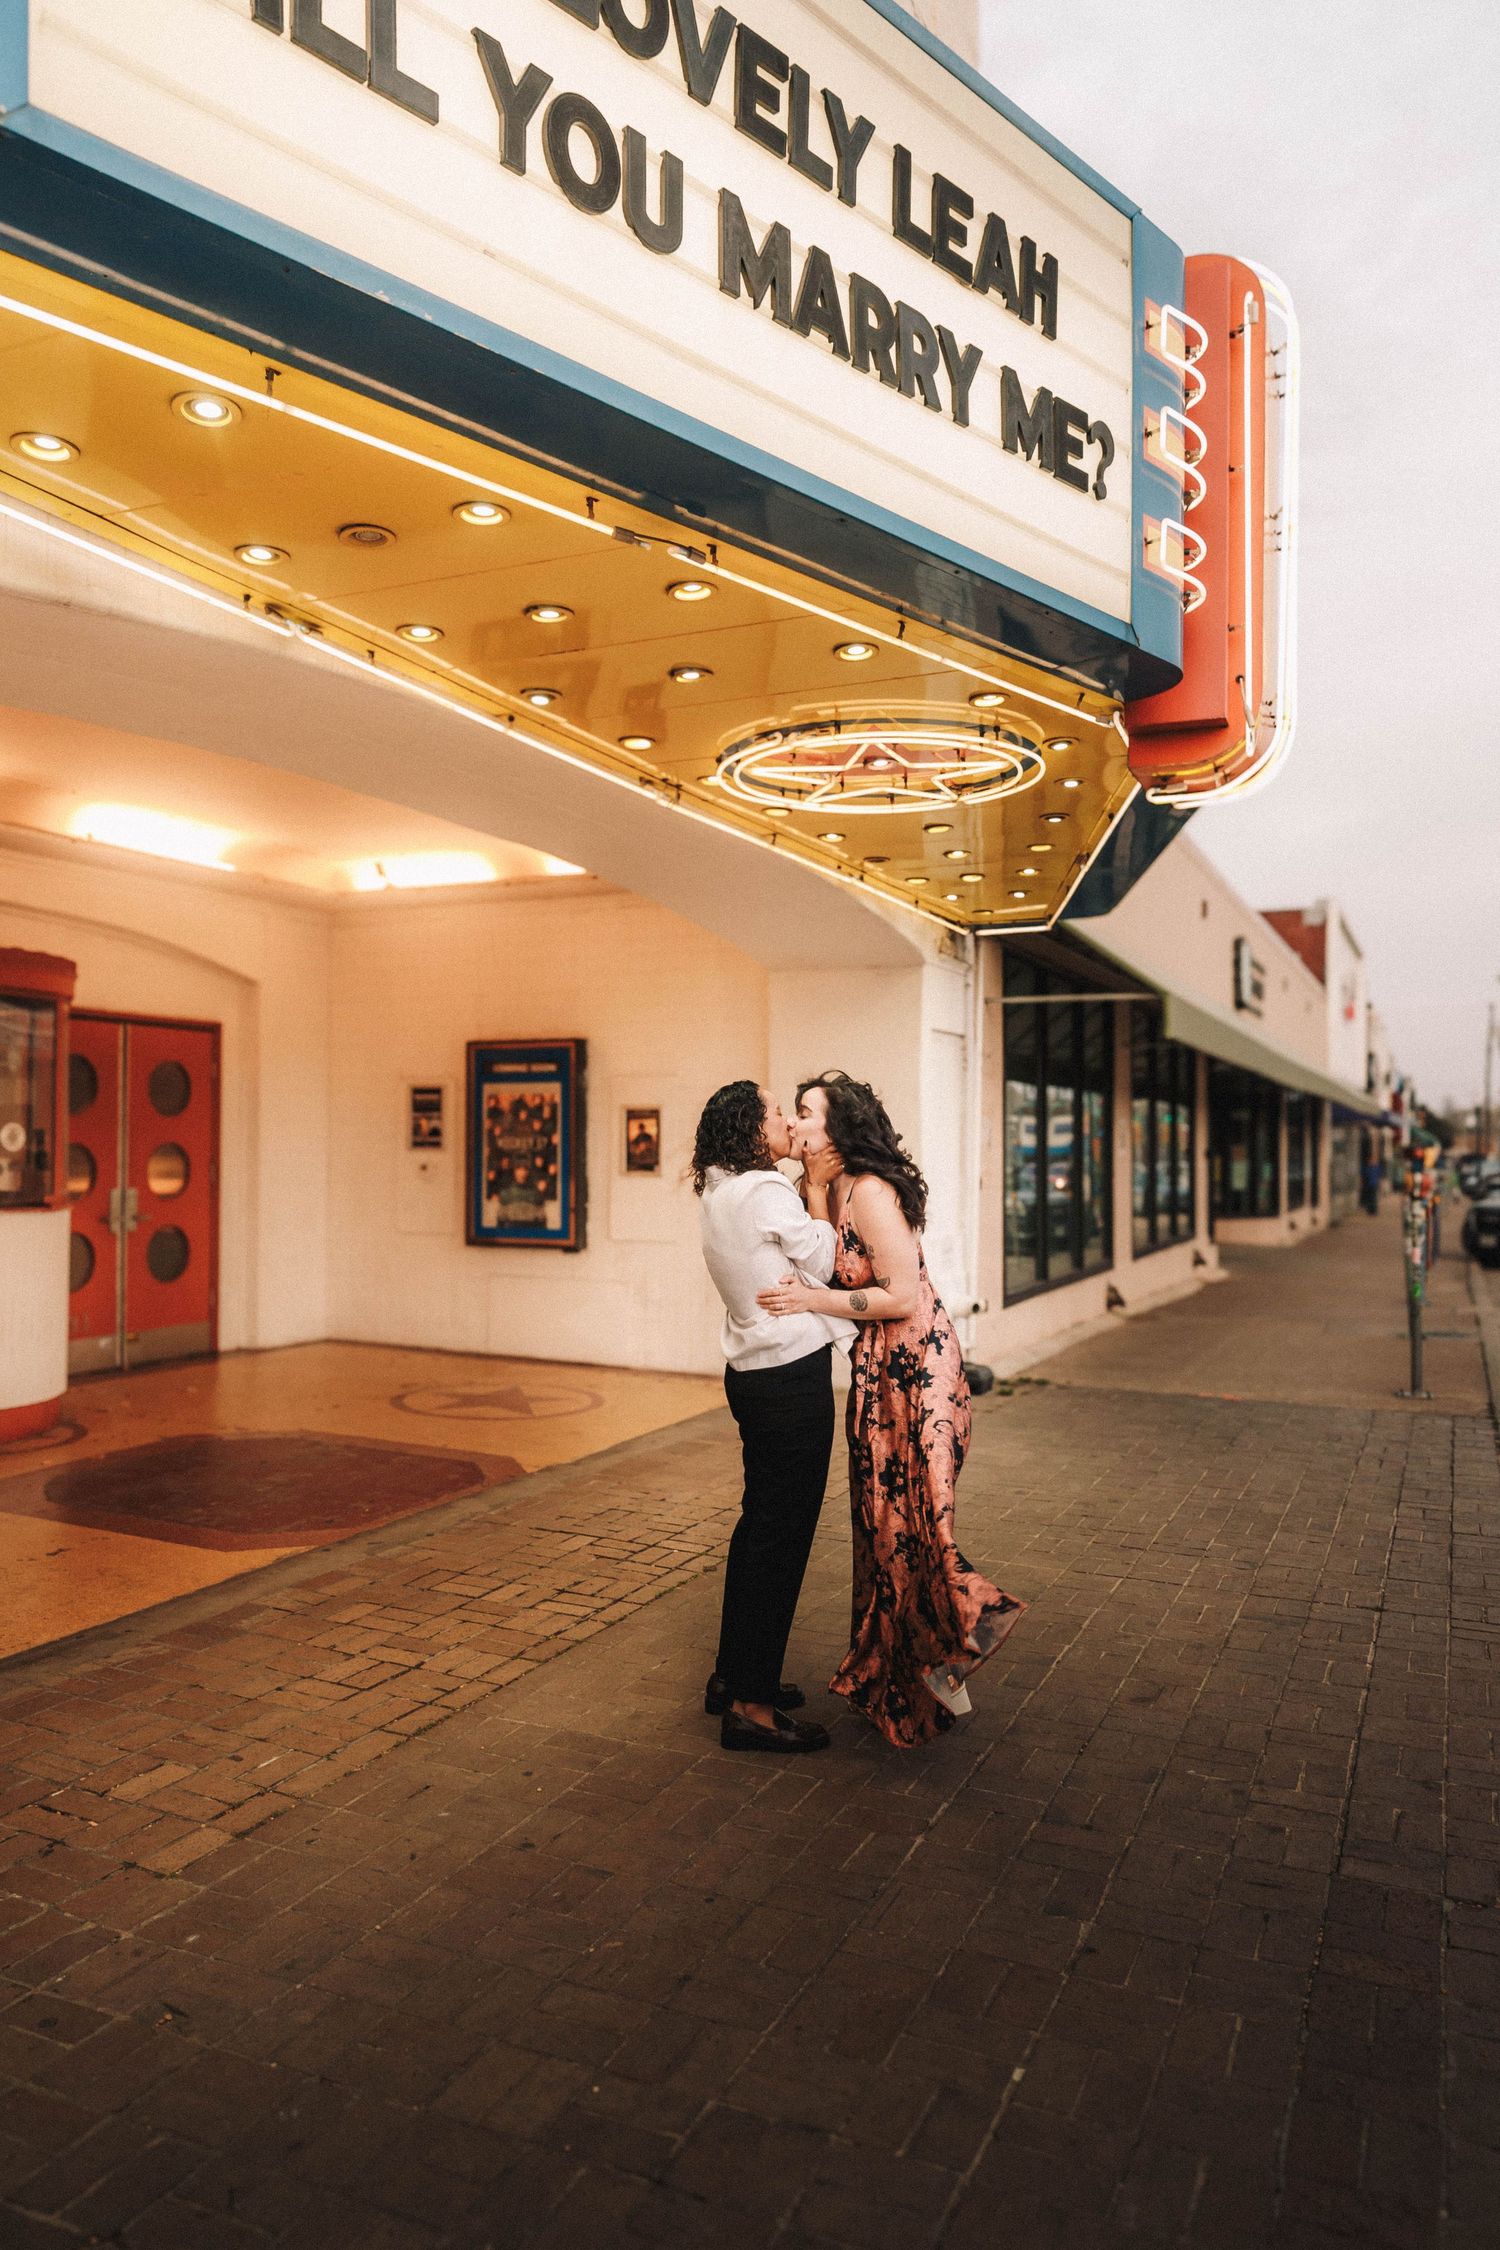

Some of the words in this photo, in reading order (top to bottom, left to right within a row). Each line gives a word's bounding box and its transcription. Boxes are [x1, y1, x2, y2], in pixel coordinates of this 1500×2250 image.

[470, 26, 684, 255] YOU
[718, 187, 983, 428] MARRY
[1000, 365, 1115, 501] ME?
[546, 0, 876, 208] OVELY
[892, 143, 1059, 341] LEAH
